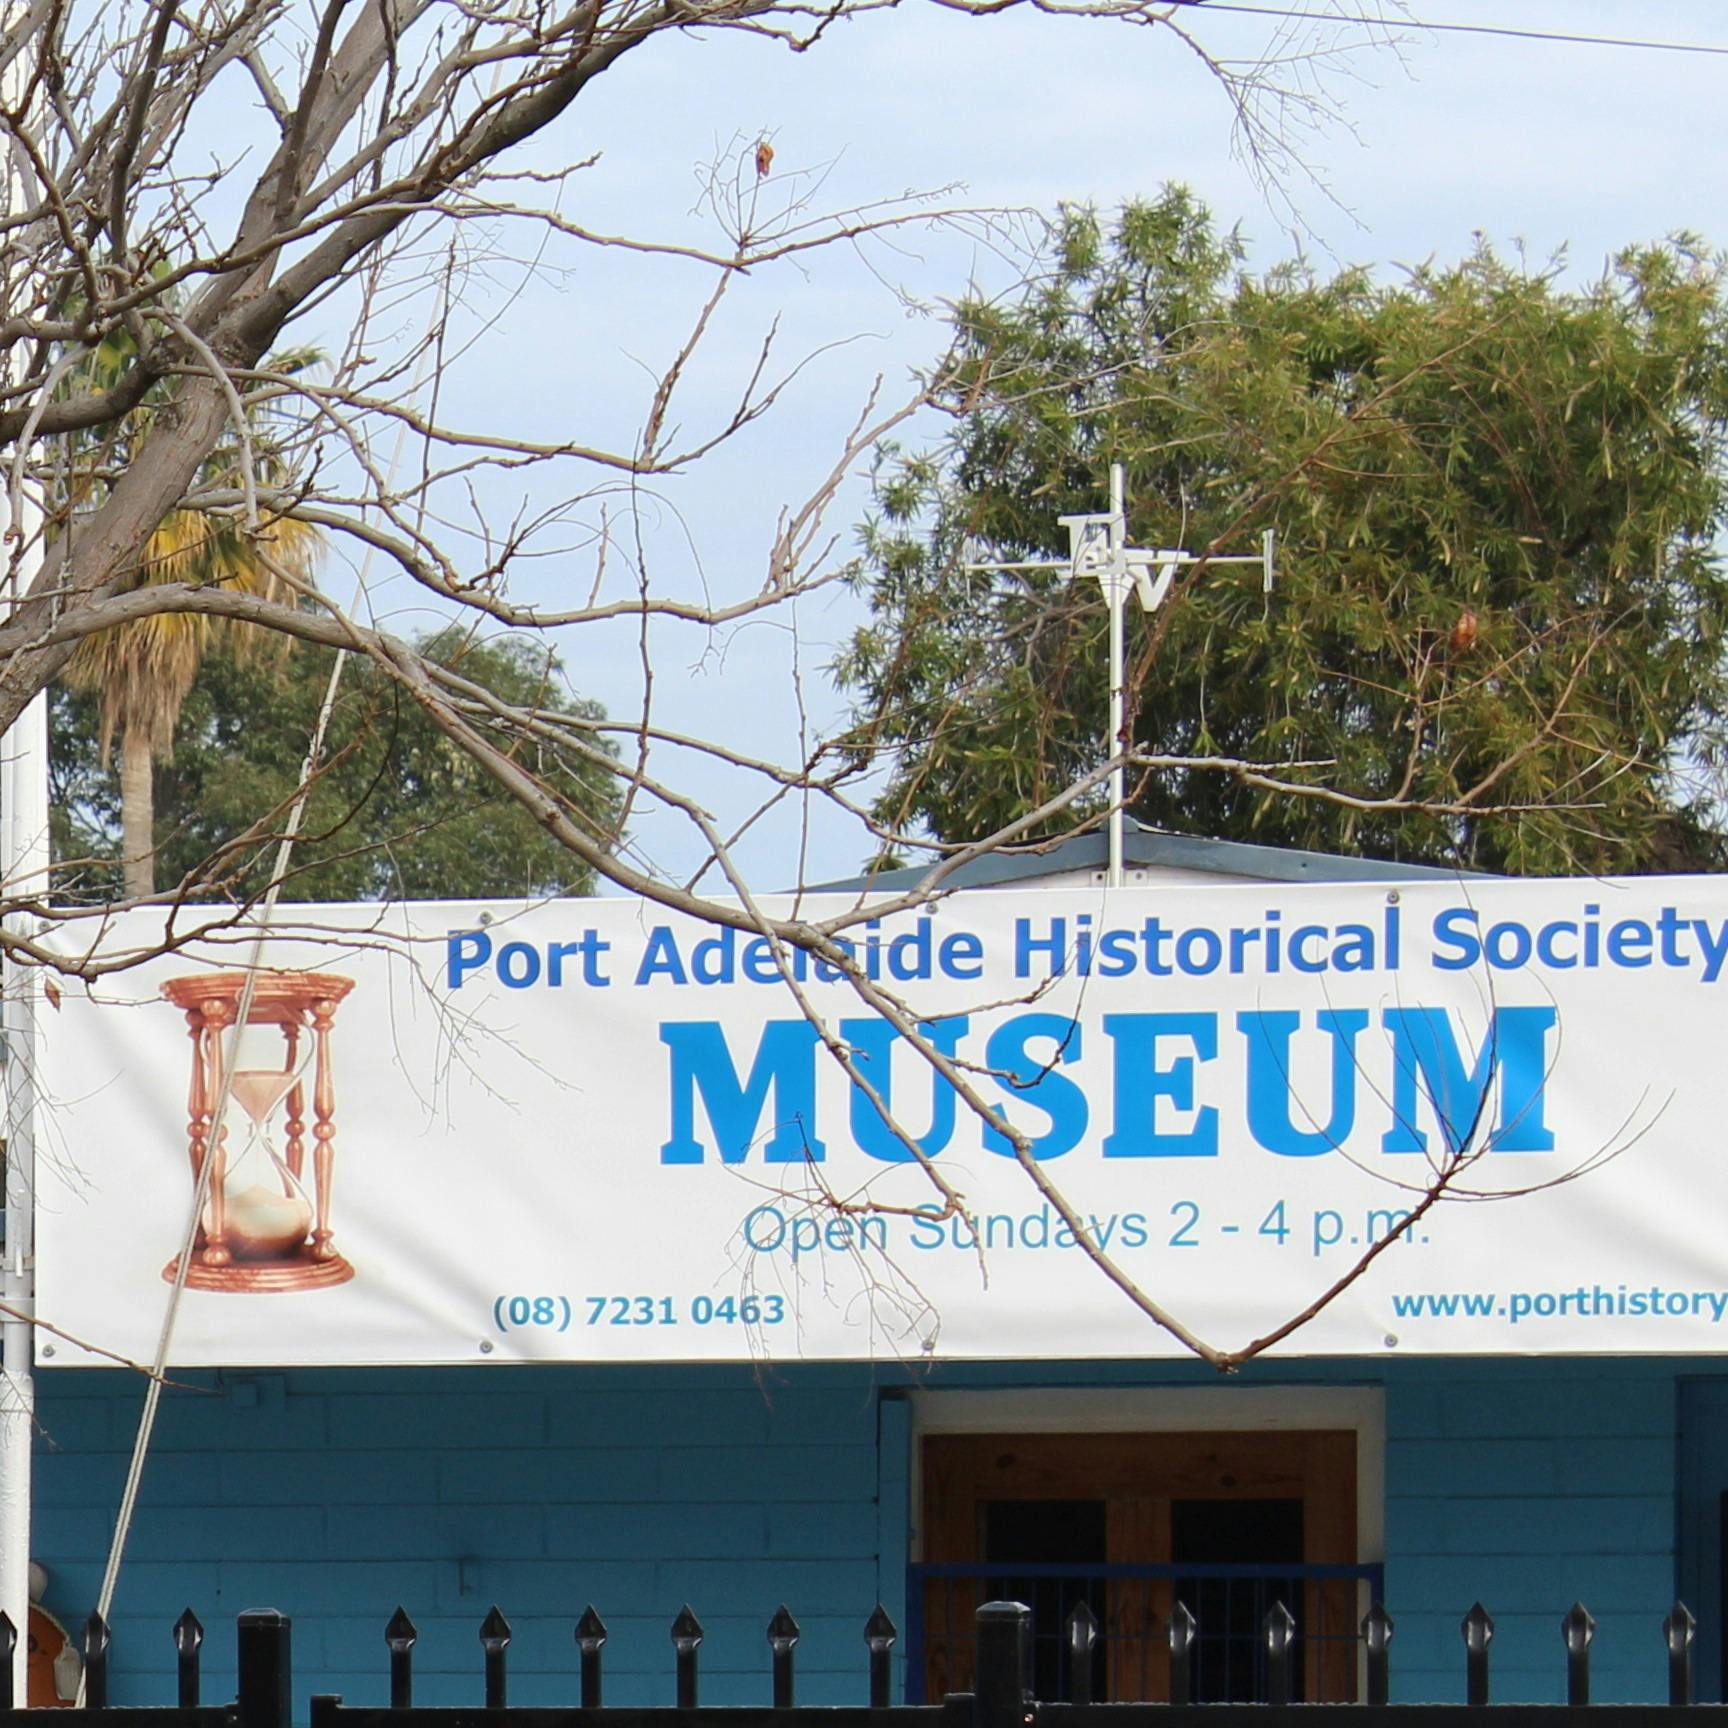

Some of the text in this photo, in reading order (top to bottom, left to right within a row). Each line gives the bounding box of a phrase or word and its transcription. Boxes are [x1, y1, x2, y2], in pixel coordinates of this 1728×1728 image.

[447, 903, 1728, 989] Port Adelaide Historical Society
[658, 1005, 1558, 1166] MUSEUM
[744, 1205, 887, 1263] Open
[909, 1202, 1149, 1256] Sundays
[1168, 1200, 1201, 1247] 2
[1257, 1199, 1291, 1245] 4
[1313, 1207, 1430, 1257] p.m.
[492, 1295, 785, 1333] (08) 7231 0463
